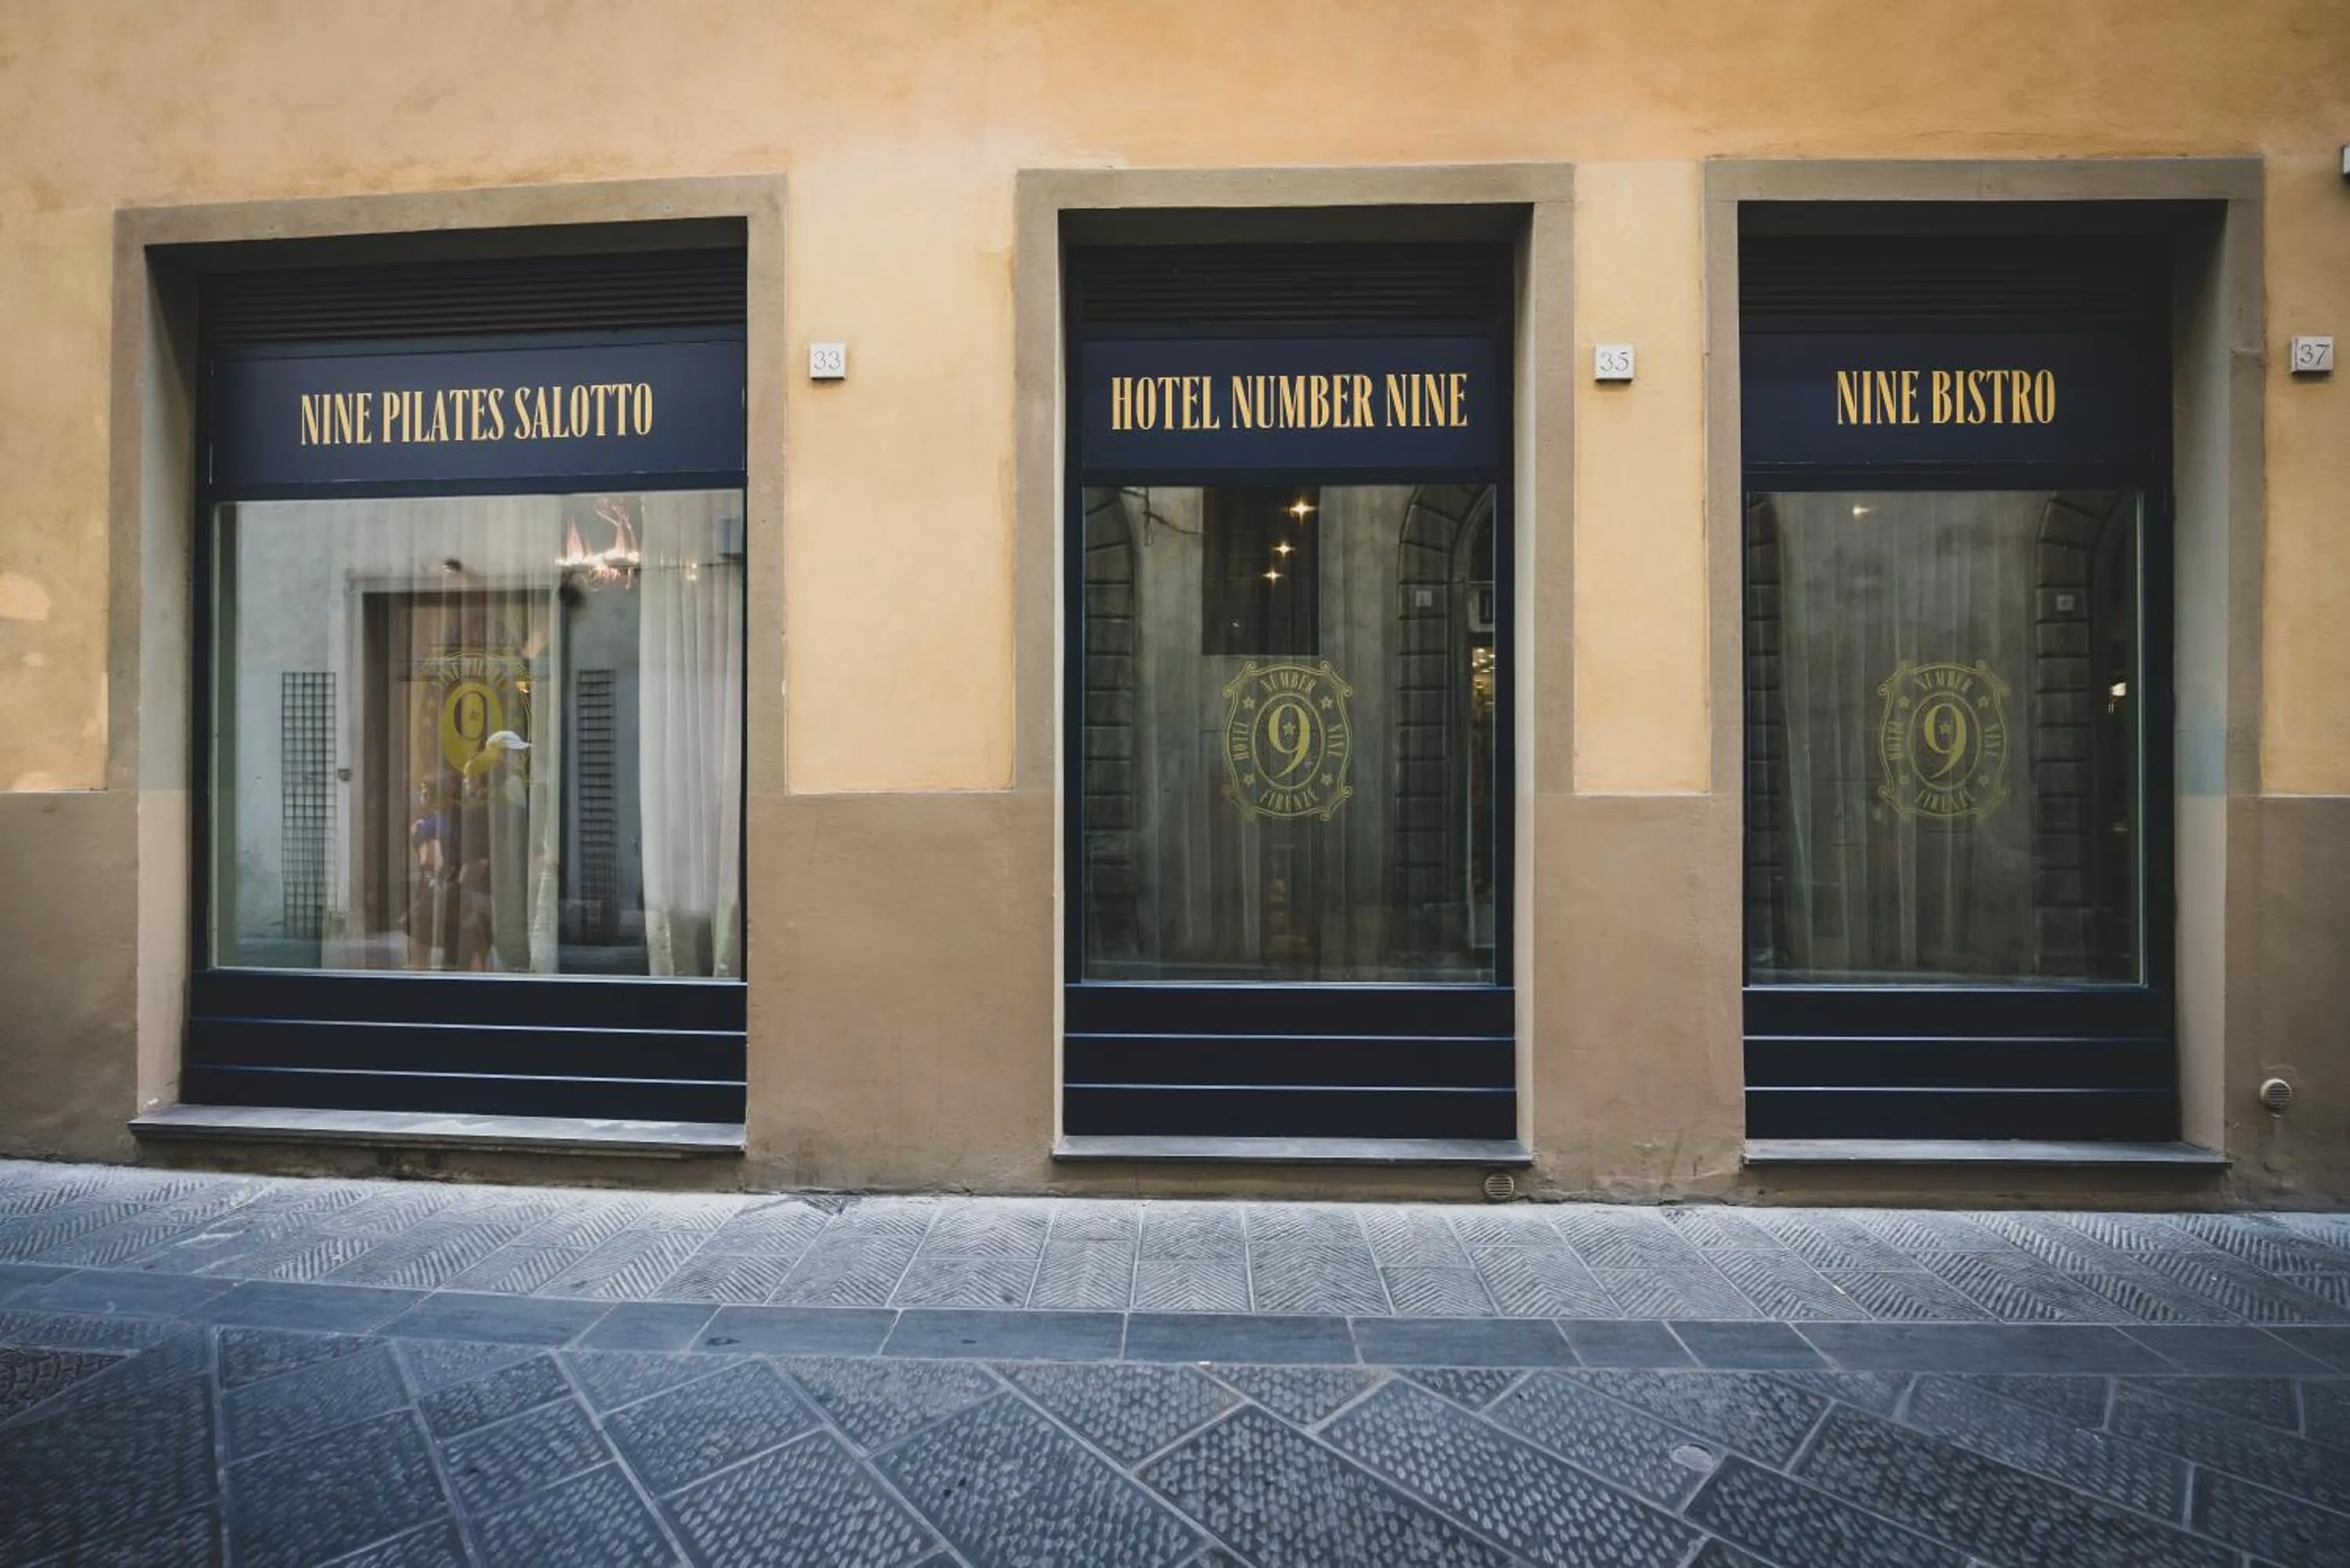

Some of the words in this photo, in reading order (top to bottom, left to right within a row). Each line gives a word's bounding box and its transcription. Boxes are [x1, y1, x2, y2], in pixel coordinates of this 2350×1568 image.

[814, 350, 841, 370] 33
[1600, 351, 1629, 371] 35
[2299, 343, 2330, 365] 37
[301, 392, 372, 446] NINE
[382, 387, 504, 443] PILATES
[514, 382, 653, 440] SALOTTO
[1112, 376, 1220, 430] HOTEL
[1232, 374, 1375, 428] NUMBER
[1386, 374, 1468, 428] NINE
[1836, 370, 1920, 425] NINE
[1932, 370, 2056, 425] BISTRO
[1267, 703, 1311, 779] 9
[1923, 702, 1968, 779] 9
